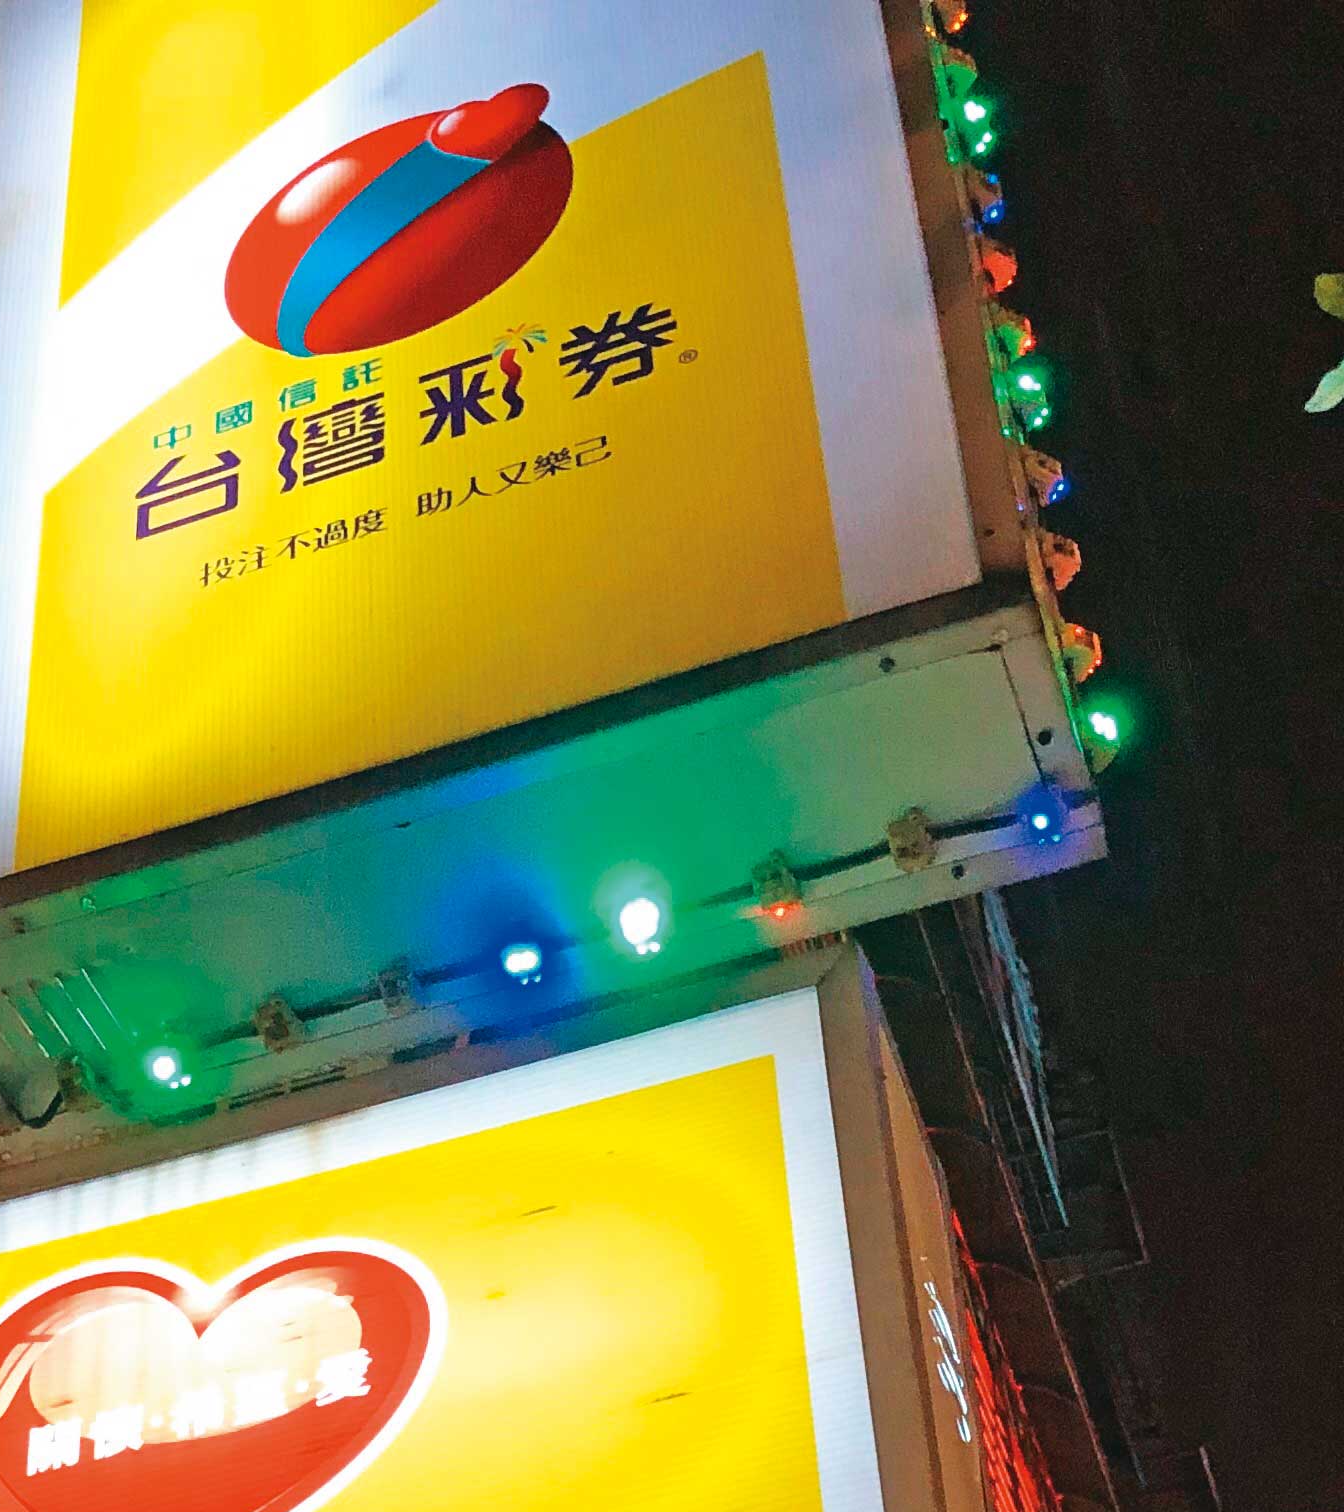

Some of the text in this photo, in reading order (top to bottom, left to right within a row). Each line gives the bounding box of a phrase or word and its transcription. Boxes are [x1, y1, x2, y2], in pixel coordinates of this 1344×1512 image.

[154, 357, 383, 449] 中國信託
[199, 436, 613, 586] 投注不過度 助人又樂己
